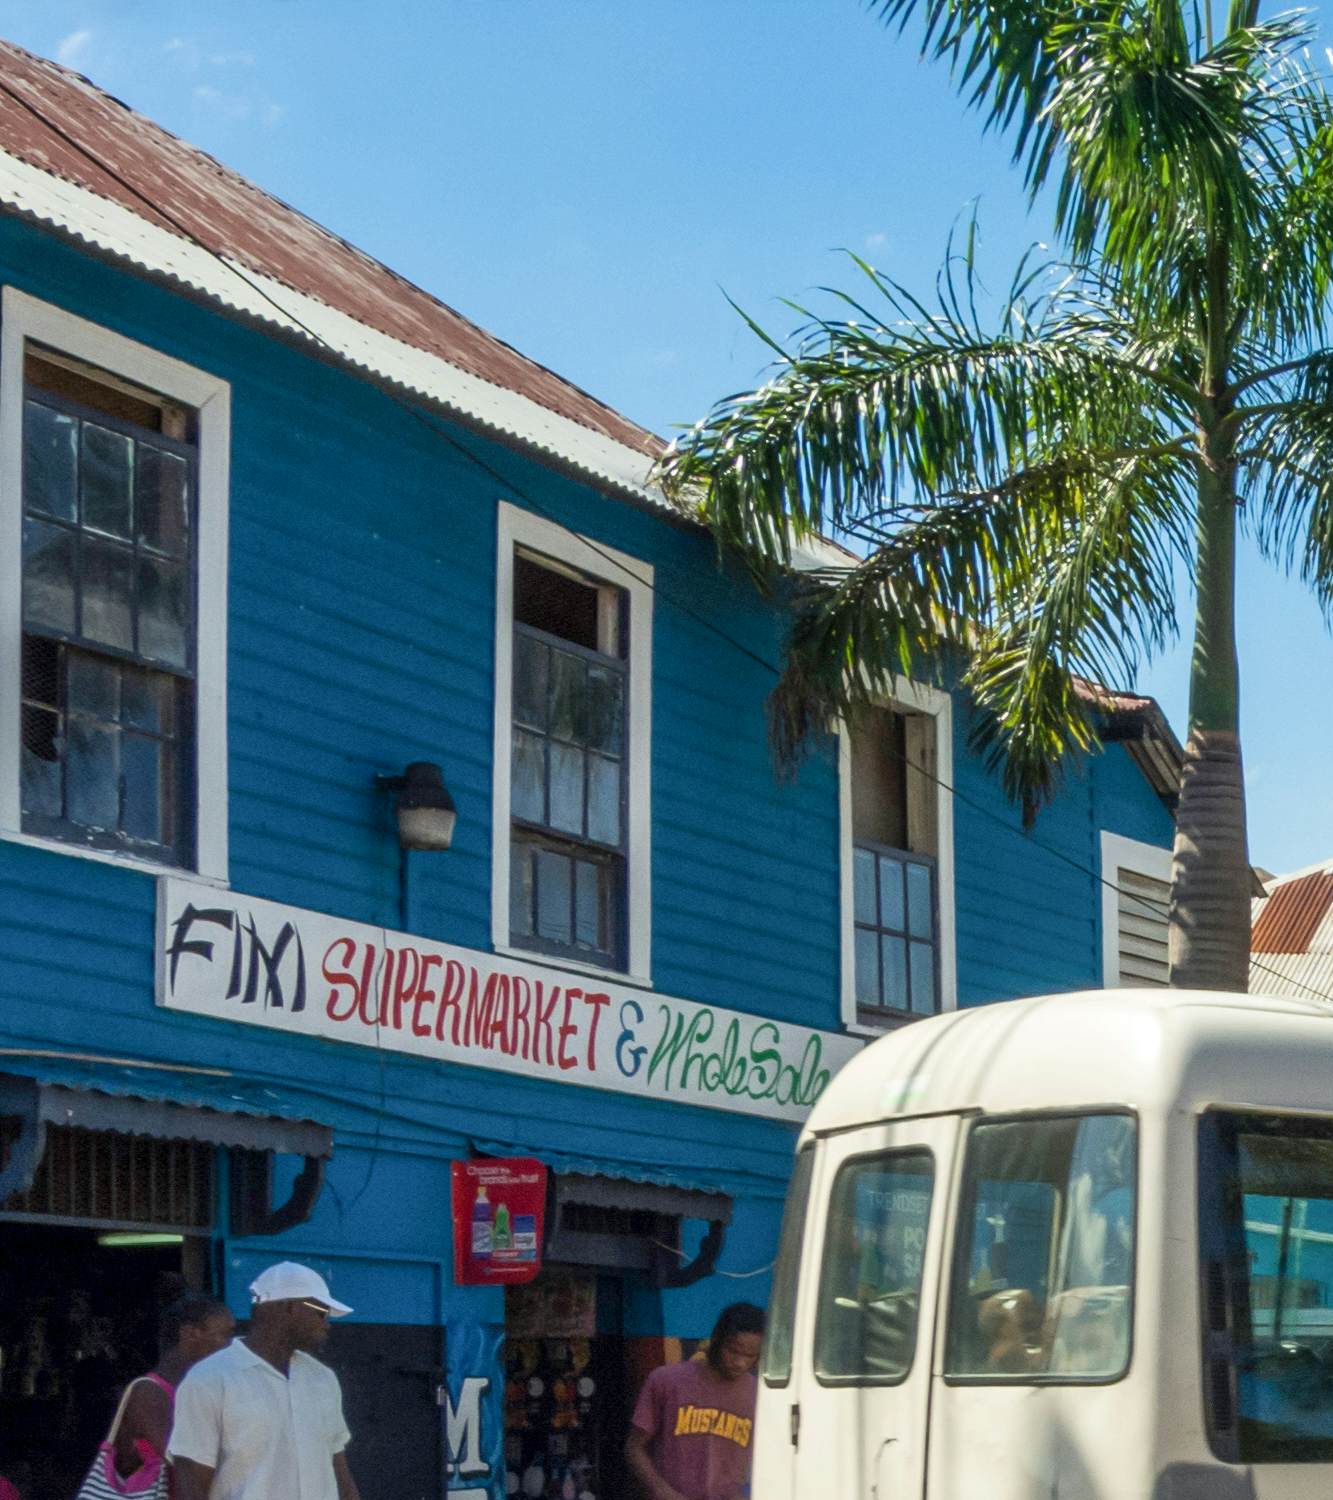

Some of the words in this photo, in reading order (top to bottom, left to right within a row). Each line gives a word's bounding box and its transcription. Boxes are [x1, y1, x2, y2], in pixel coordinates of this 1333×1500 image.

[322, 937, 610, 1072] SUPERMARKET
[615, 1000, 648, 1078] &
[674, 1405, 753, 1448] MUSTANGS
